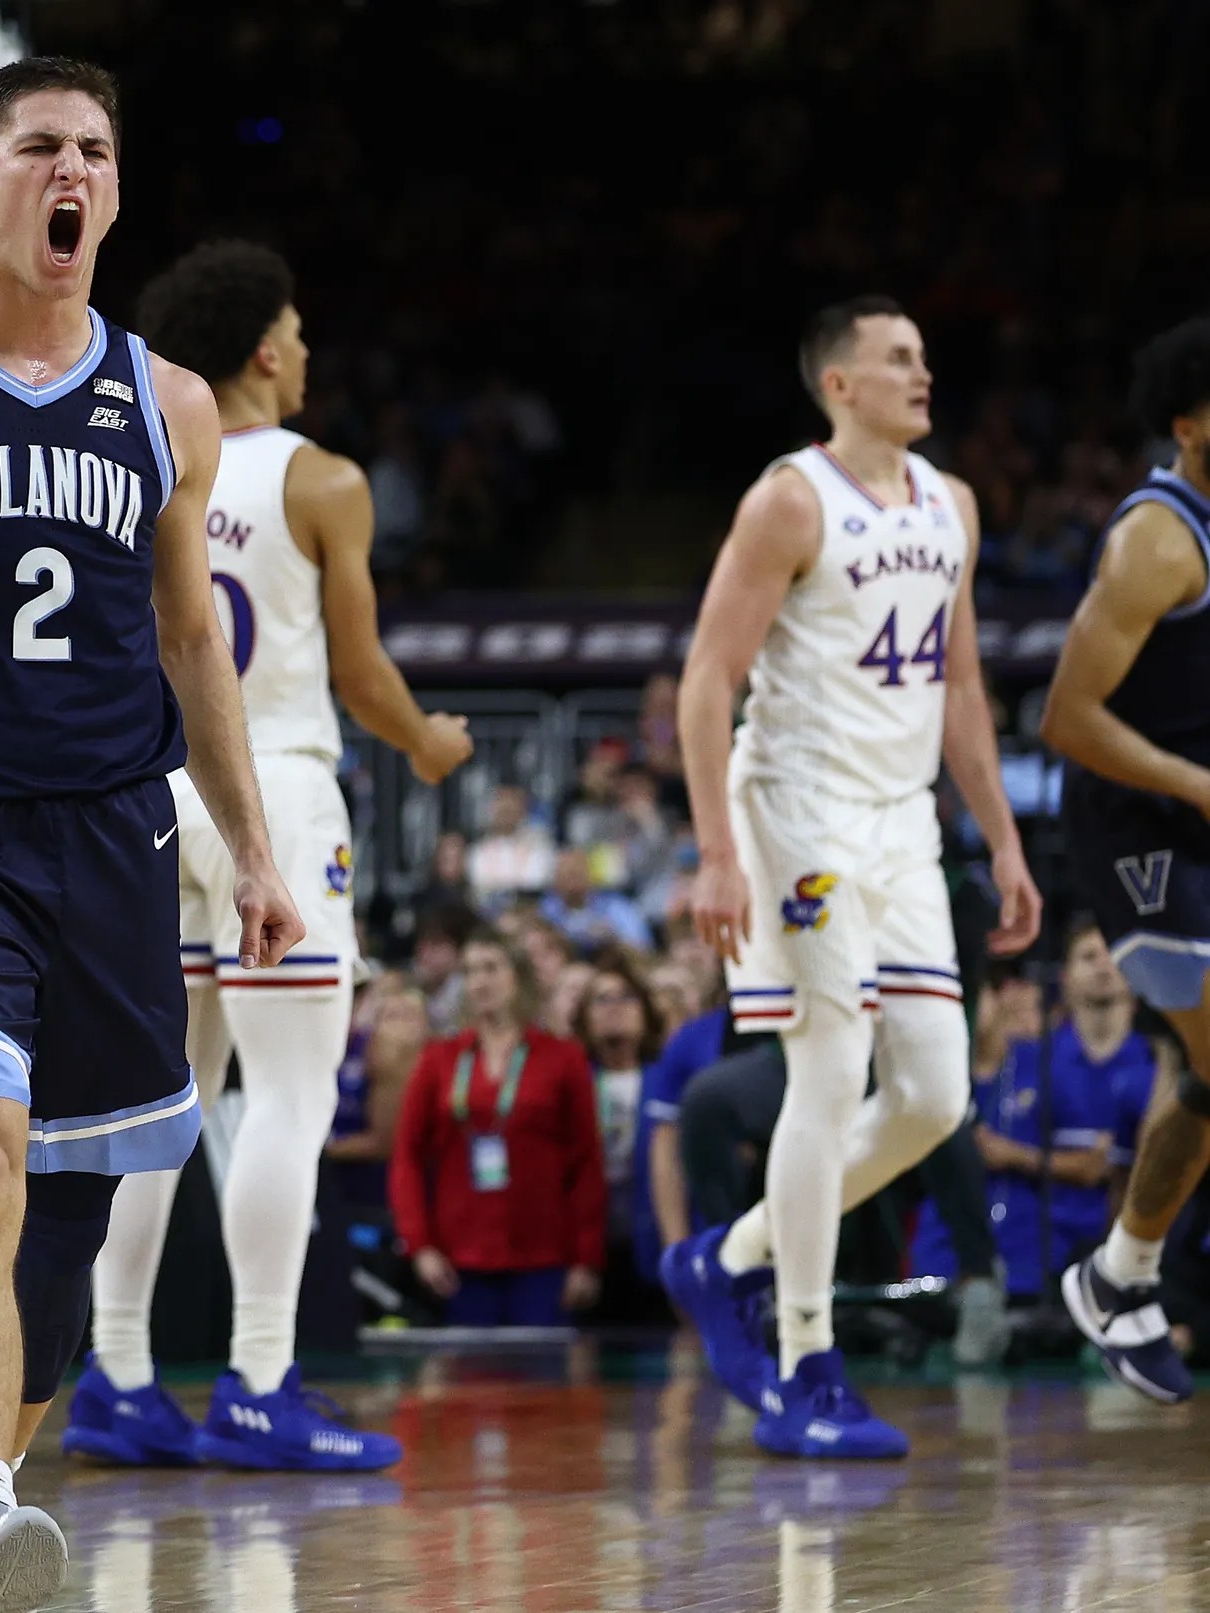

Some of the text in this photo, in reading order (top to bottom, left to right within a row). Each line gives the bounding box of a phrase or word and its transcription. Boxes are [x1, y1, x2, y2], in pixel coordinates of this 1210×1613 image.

[94, 387, 134, 404] CHANGE
[93, 406, 122, 418] BIG
[89, 414, 129, 428] EAST
[12, 547, 75, 661] 2
[857, 602, 947, 687] 44
